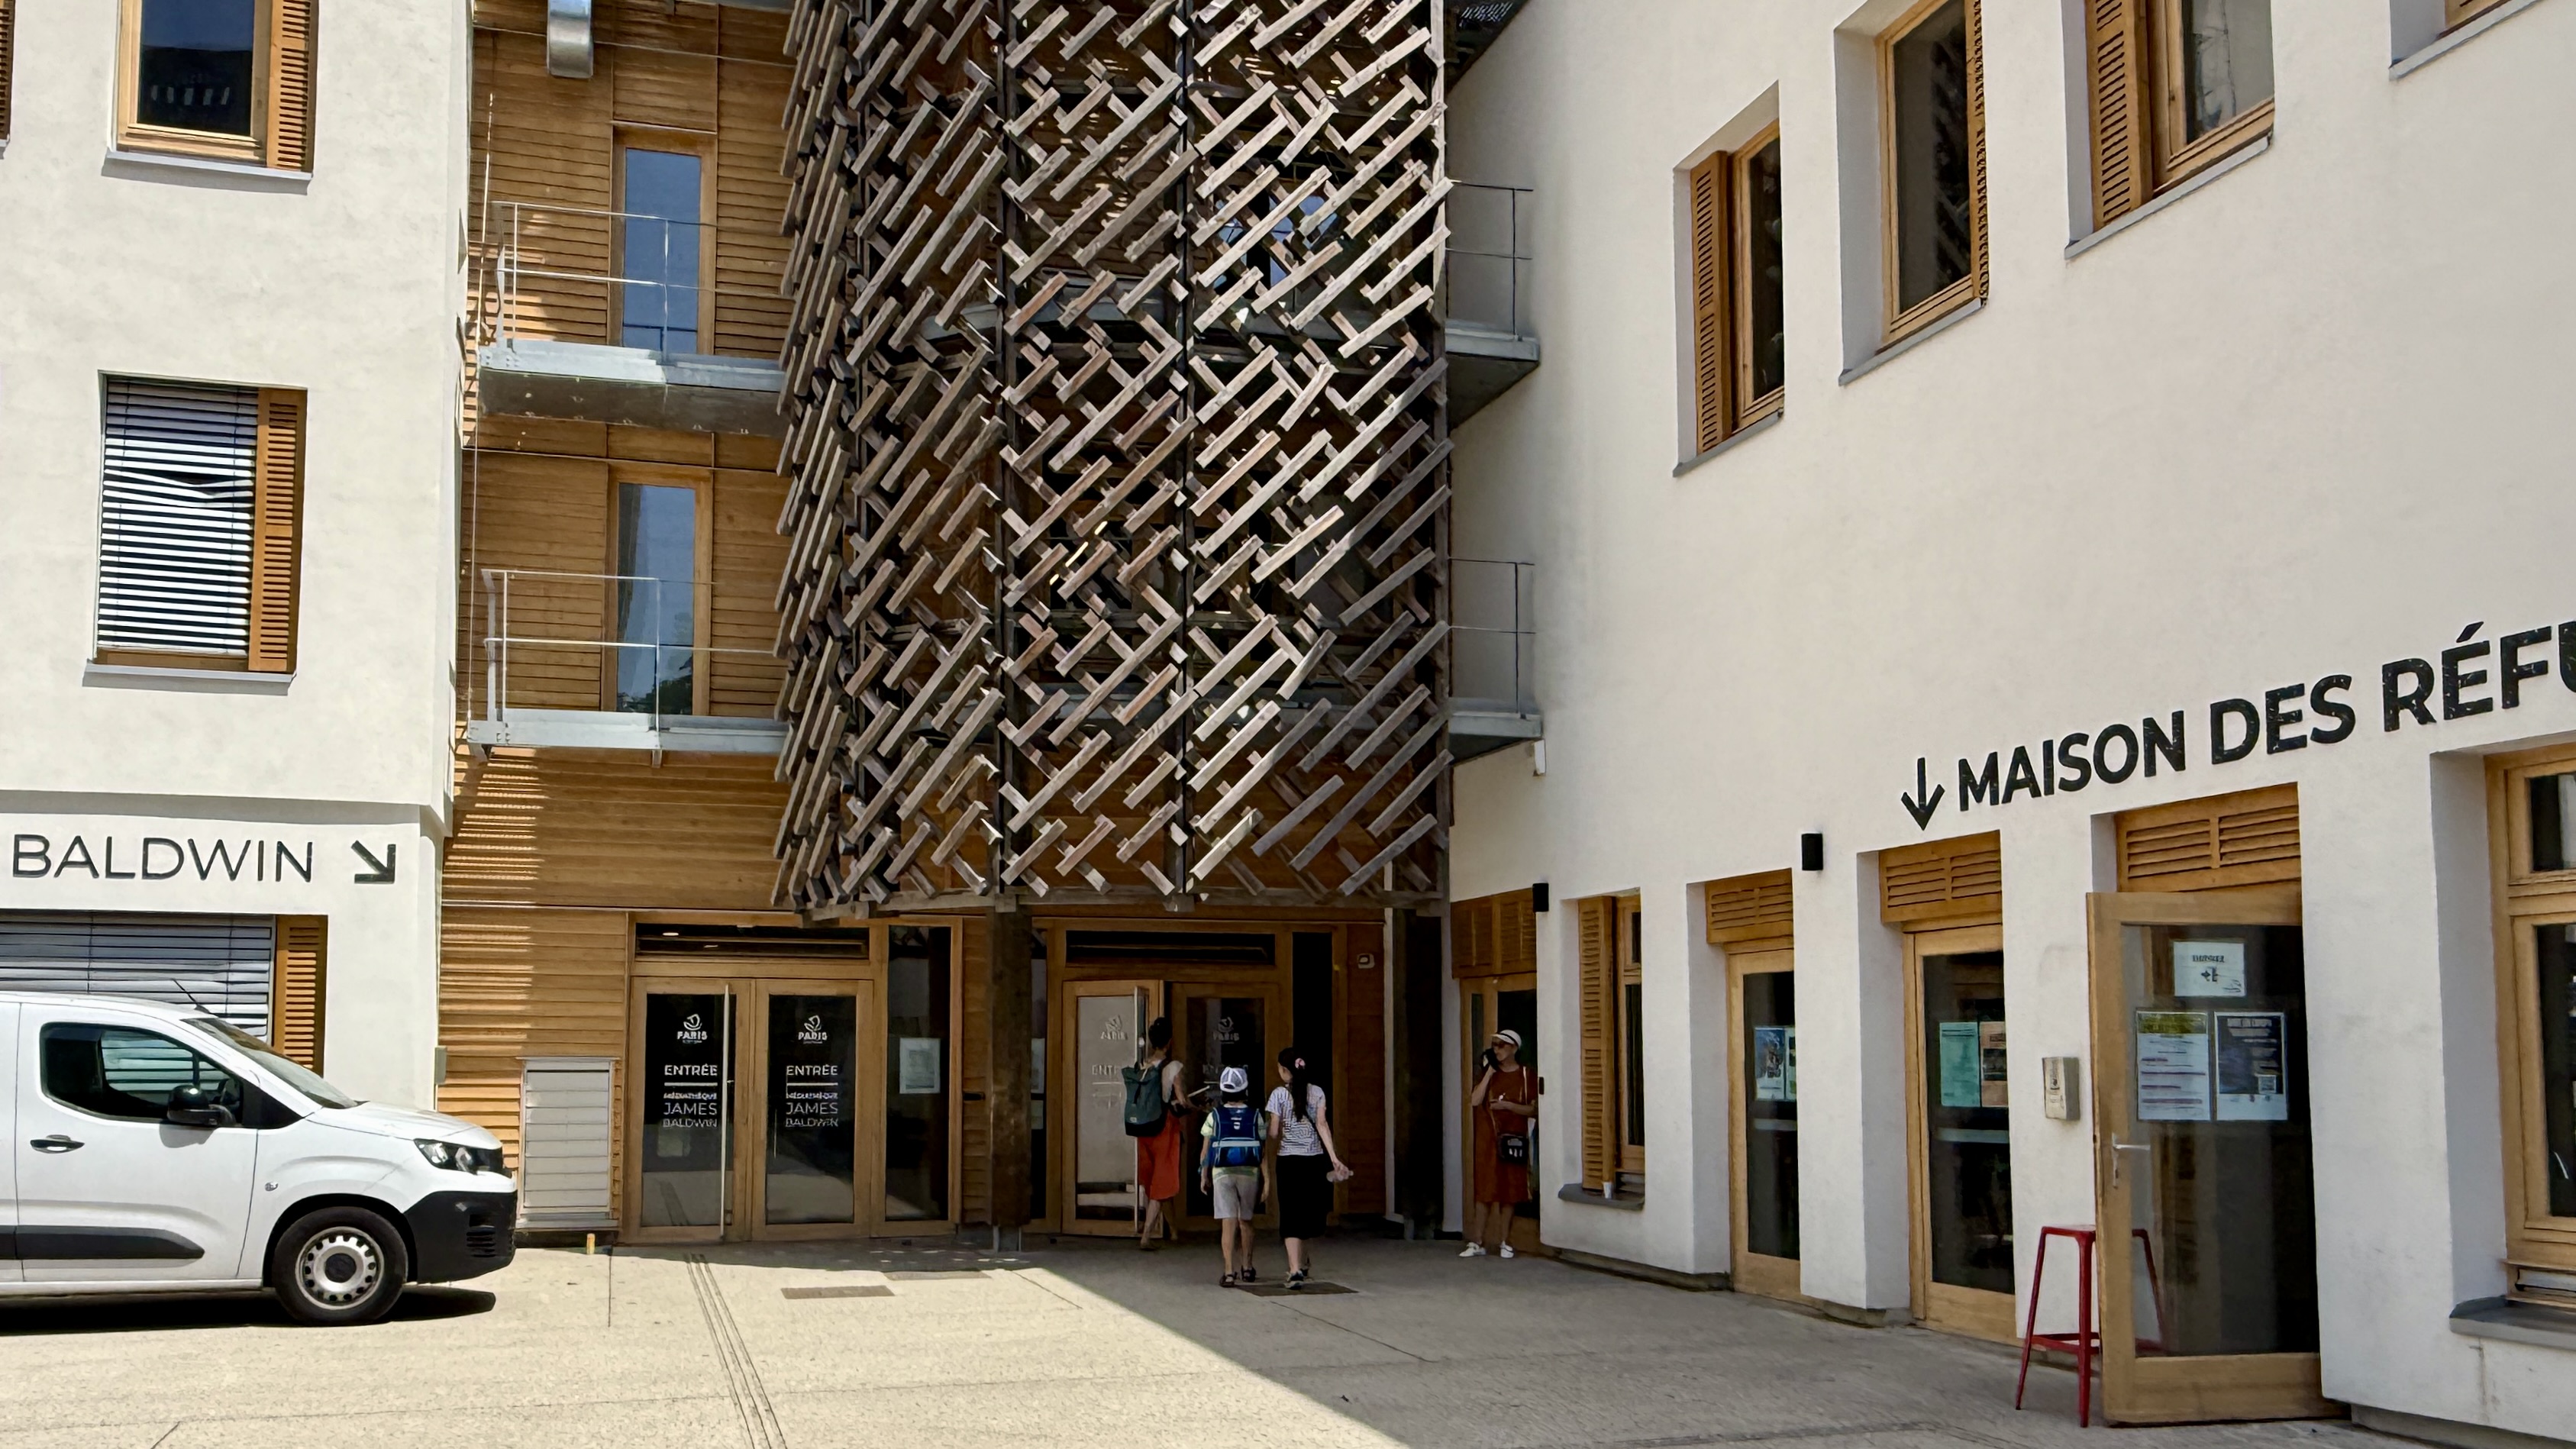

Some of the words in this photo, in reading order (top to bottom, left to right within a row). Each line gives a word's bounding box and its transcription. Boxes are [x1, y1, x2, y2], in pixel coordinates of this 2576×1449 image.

[1958, 710, 2186, 812] MAISON
[2210, 673, 2356, 765] DES
[12, 834, 314, 883] BALDWIN
[664, 1063, 718, 1076] ENTRÉE
[786, 1064, 838, 1076] ENTRÉE
[663, 1102, 718, 1115] JAMES
[786, 1102, 838, 1115] JAMES
[663, 1118, 718, 1128] BALDWIN
